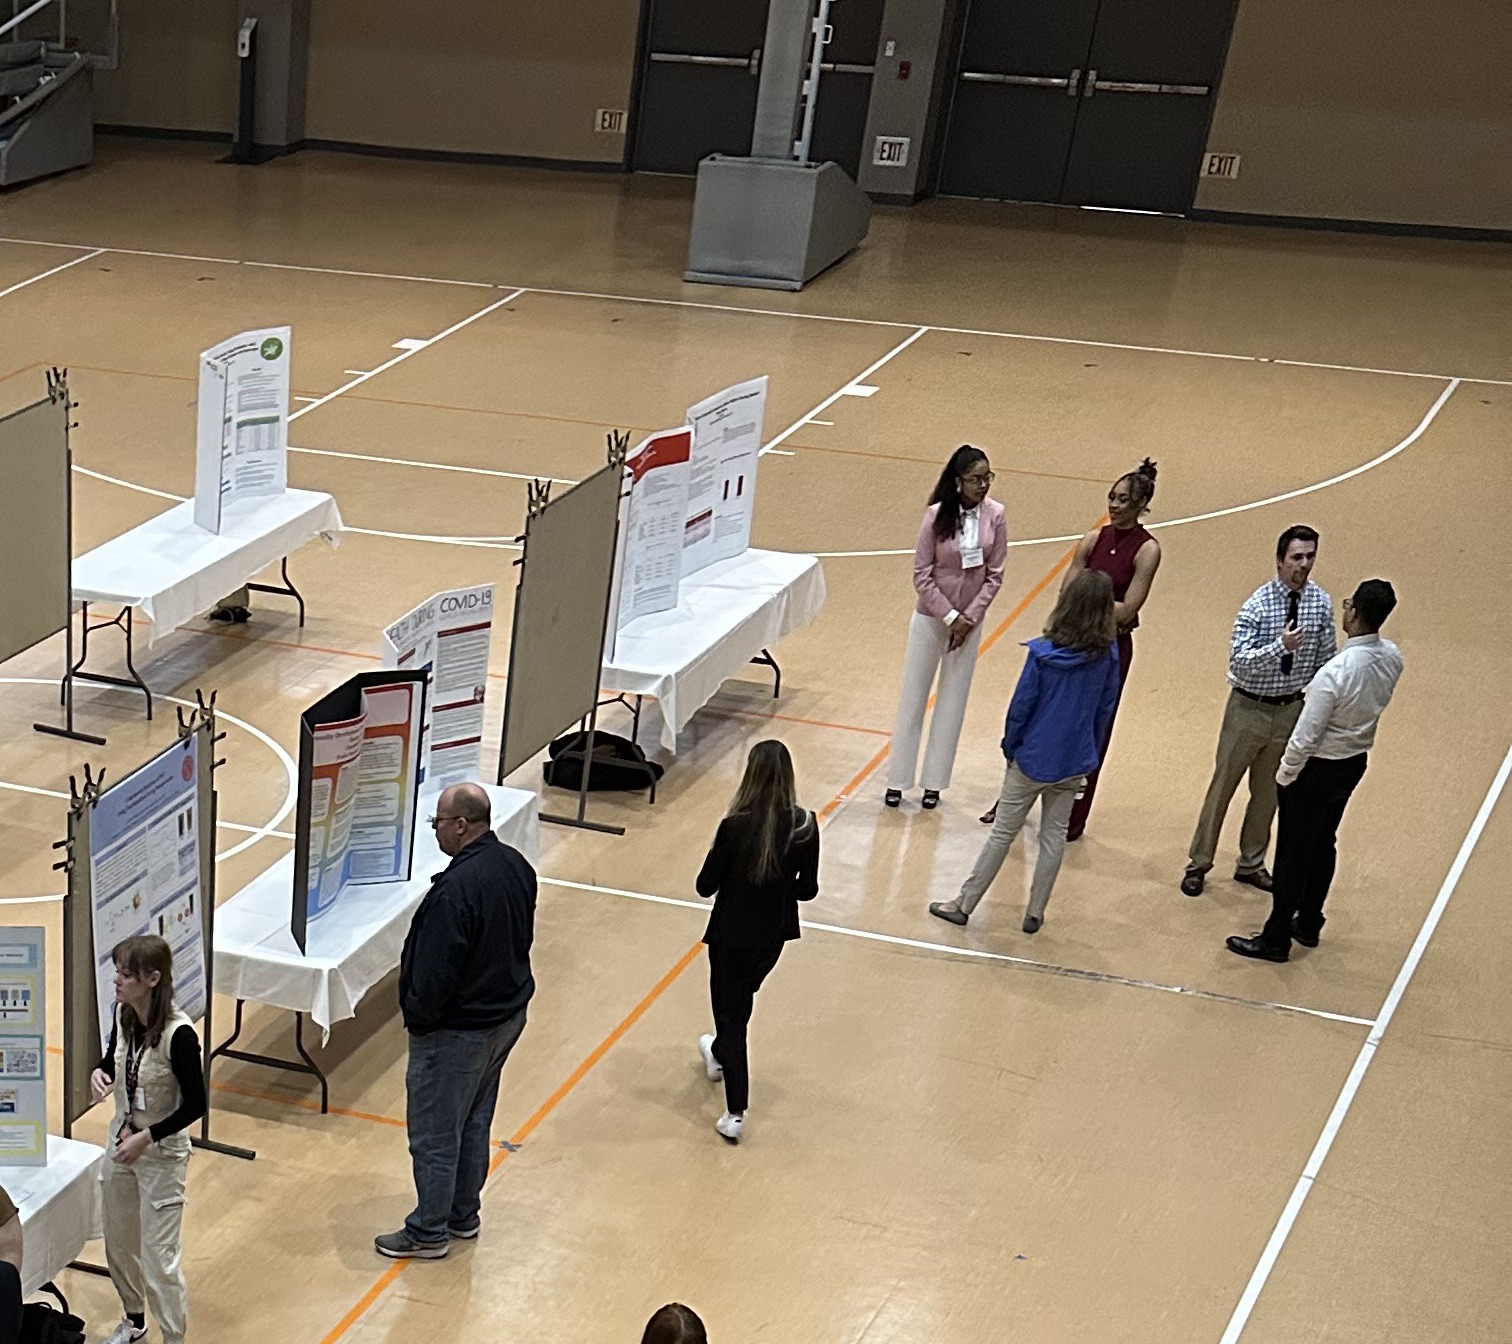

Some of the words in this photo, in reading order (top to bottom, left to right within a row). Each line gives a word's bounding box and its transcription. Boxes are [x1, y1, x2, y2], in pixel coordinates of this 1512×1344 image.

[601, 110, 623, 131] EXIT
[879, 141, 904, 161] EXIT
[1208, 155, 1236, 176] EXIT
[439, 589, 492, 613] COVID-19
